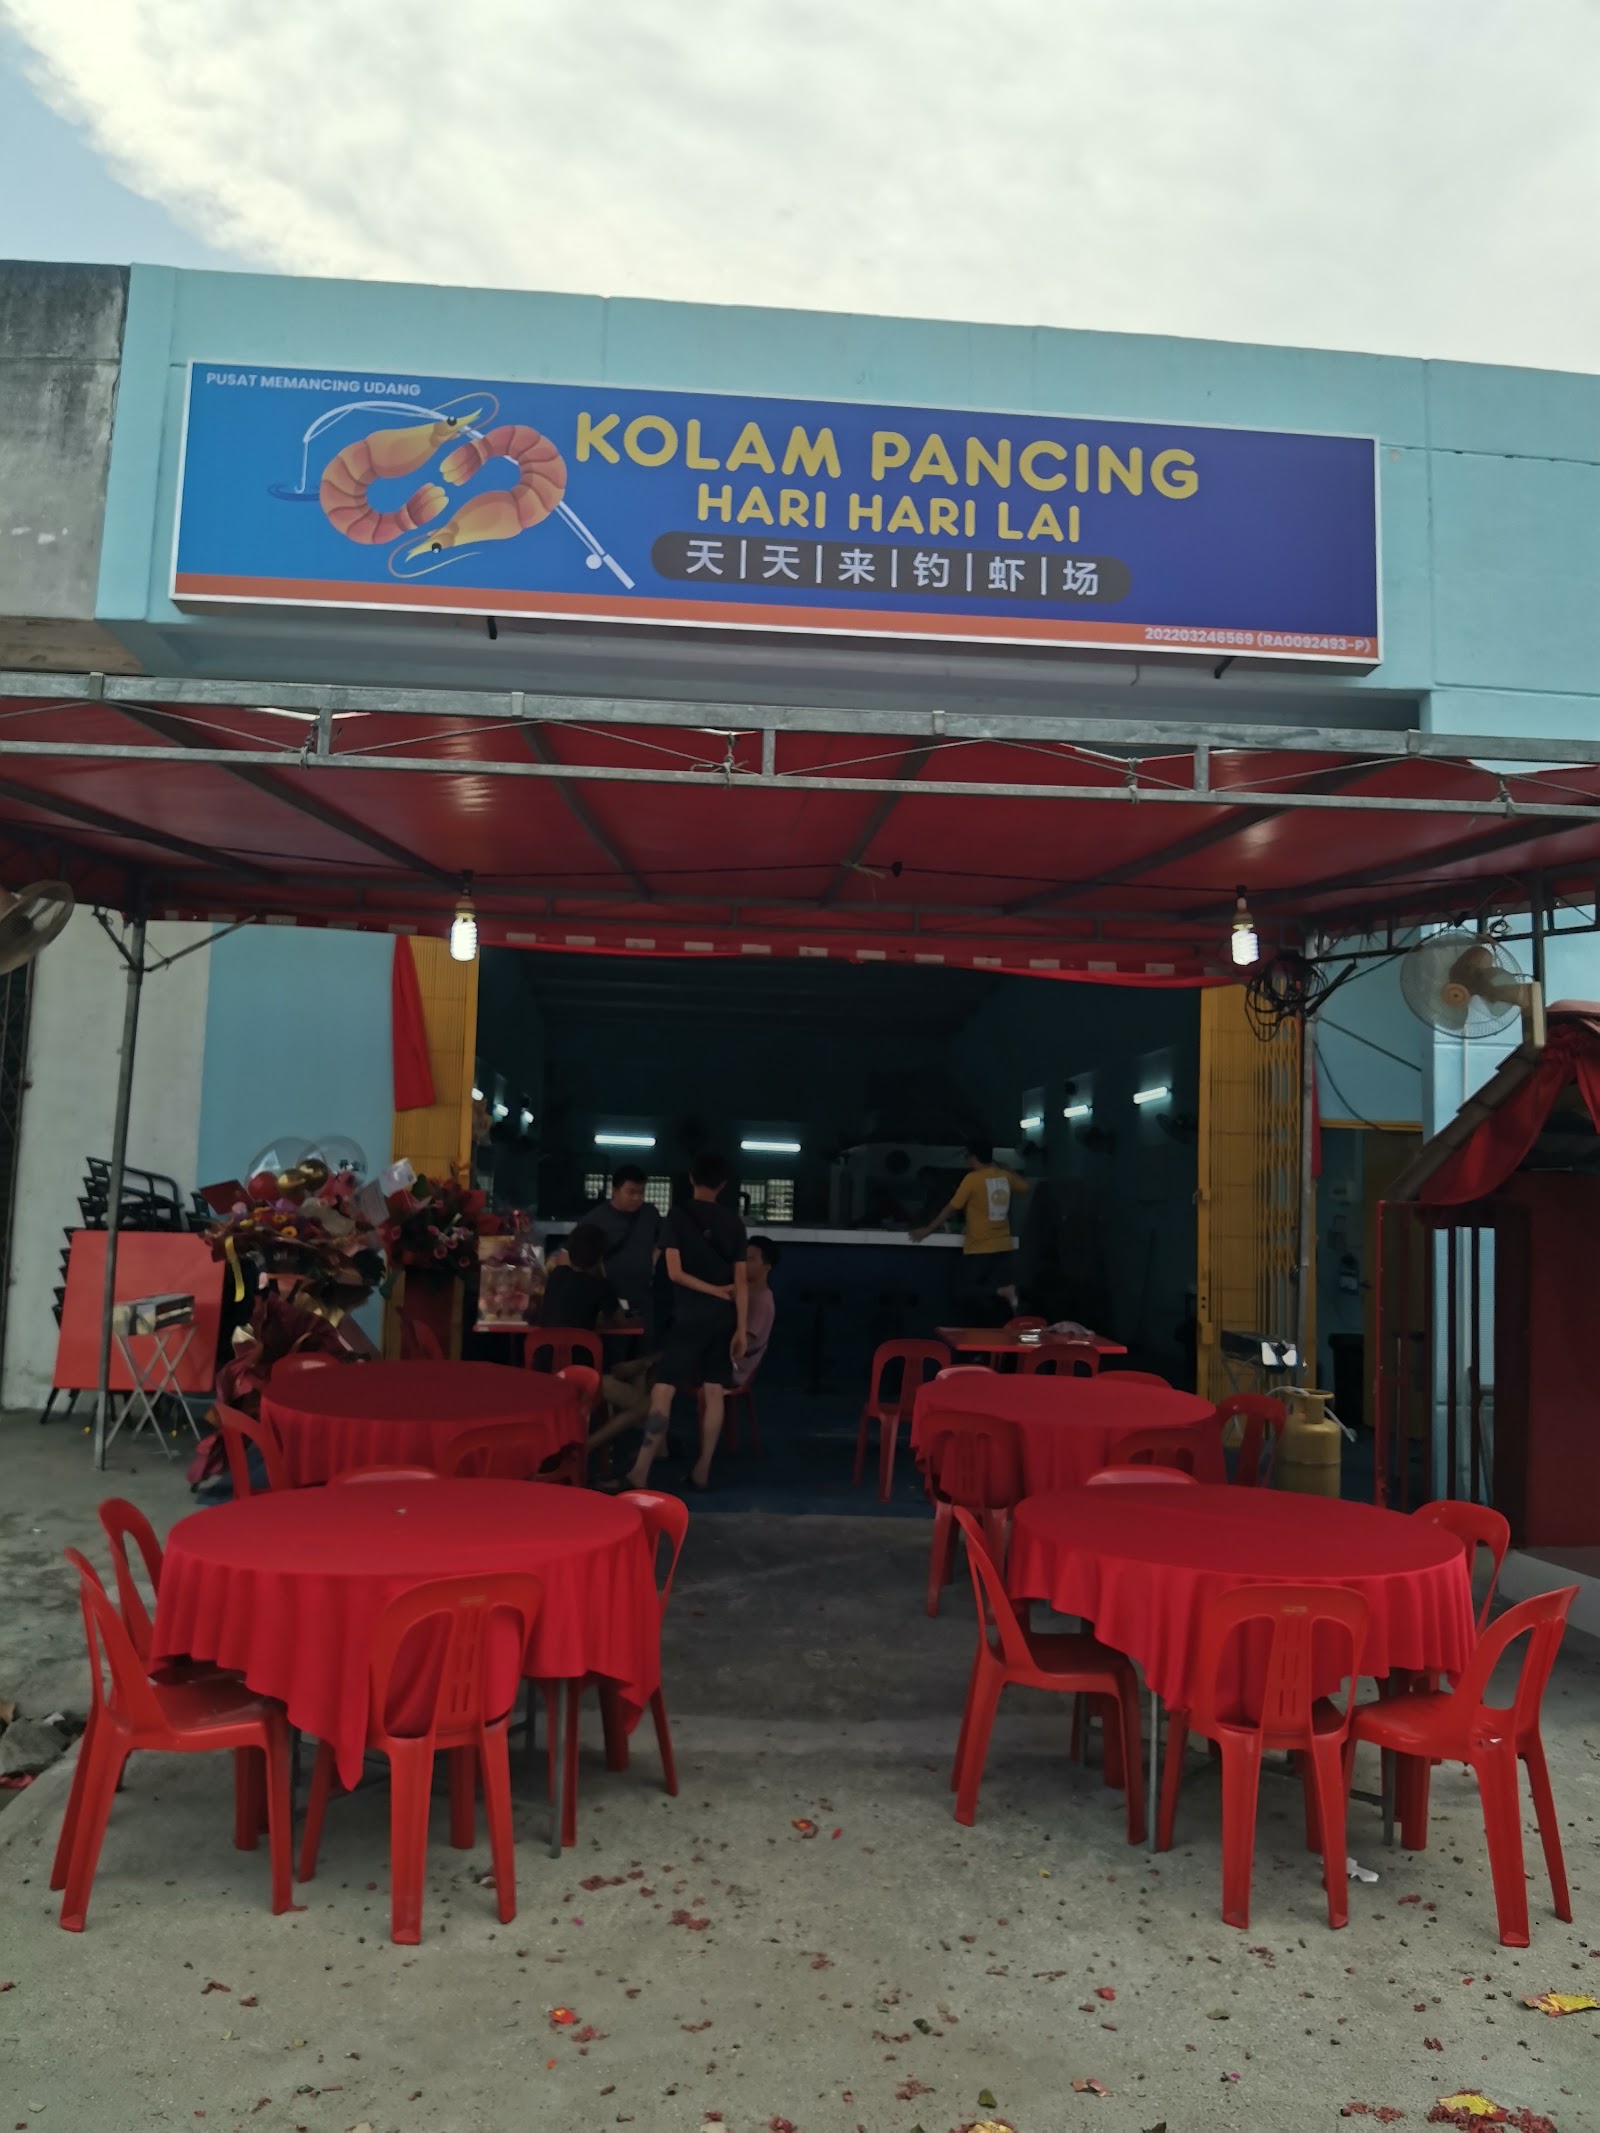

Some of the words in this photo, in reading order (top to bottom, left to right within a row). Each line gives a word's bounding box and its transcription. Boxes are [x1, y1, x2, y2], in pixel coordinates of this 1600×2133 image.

[206, 371, 258, 387] PUSAT
[260, 376, 361, 393] MEMANCING
[364, 381, 421, 397] UDANG
[576, 411, 842, 479] KOLAM
[871, 430, 1199, 500] PANCING
[697, 483, 827, 529] HARI
[848, 492, 977, 538] HARI
[998, 501, 1081, 543] LAI
